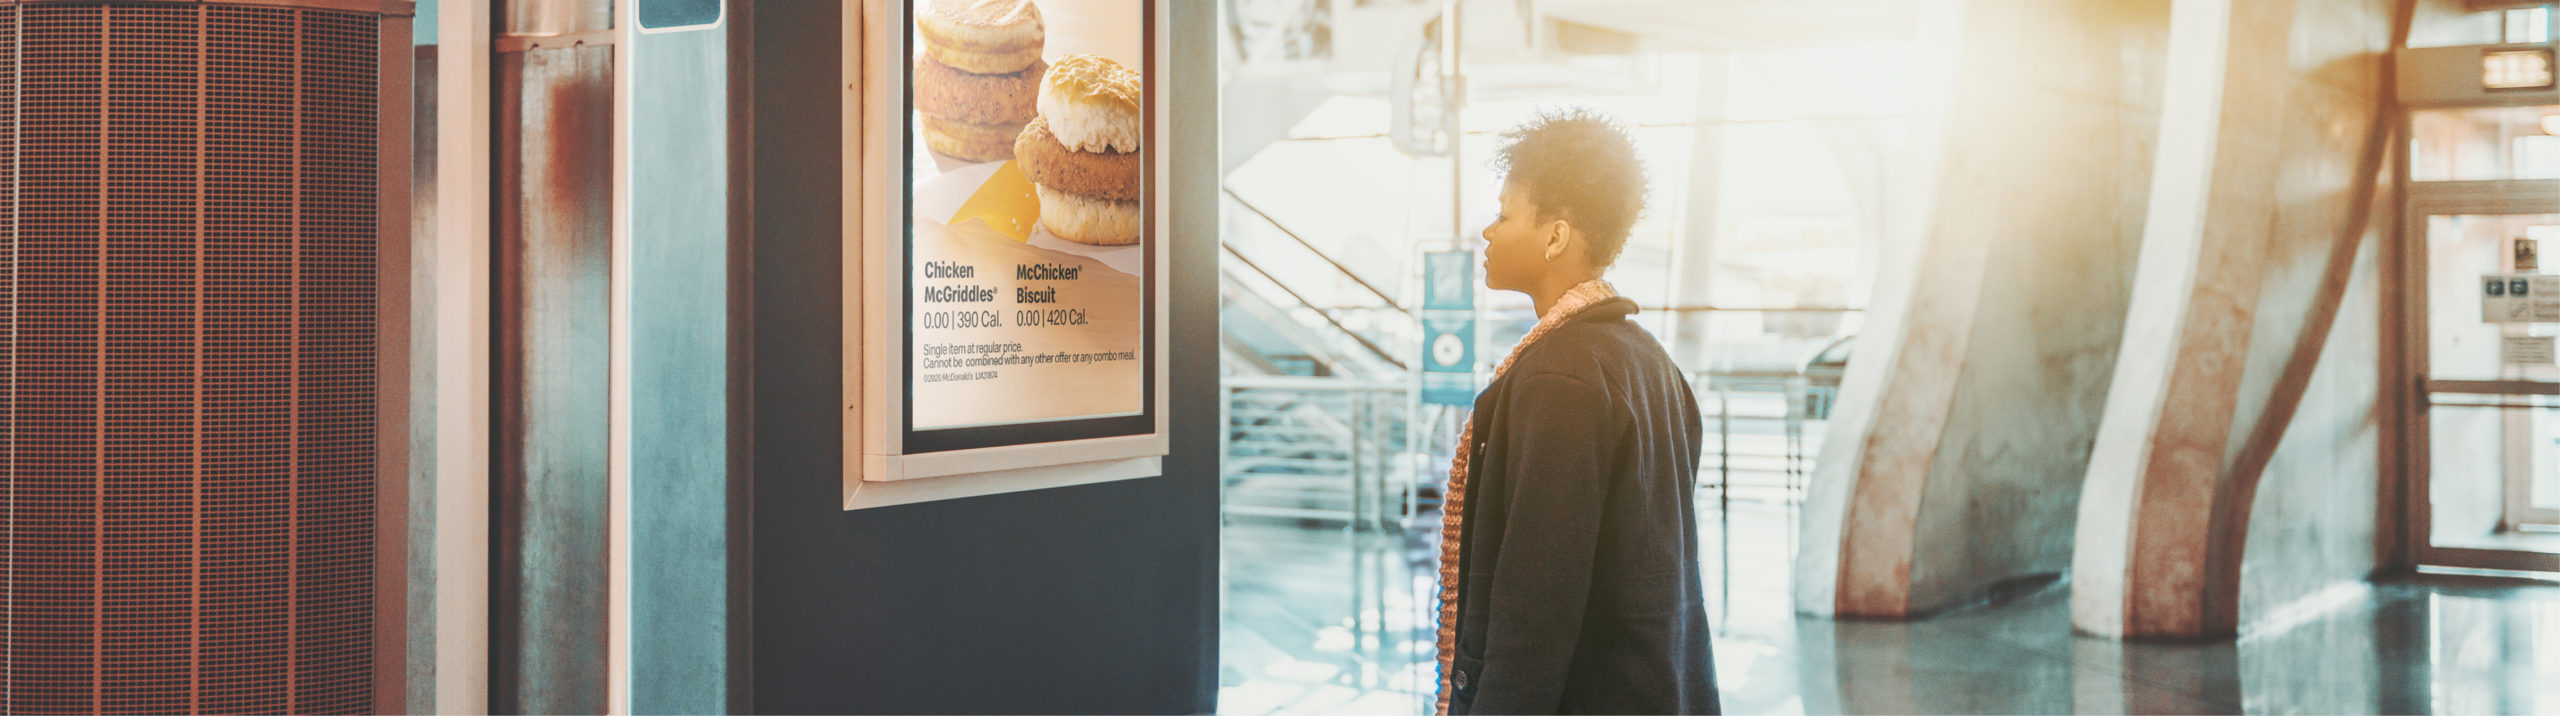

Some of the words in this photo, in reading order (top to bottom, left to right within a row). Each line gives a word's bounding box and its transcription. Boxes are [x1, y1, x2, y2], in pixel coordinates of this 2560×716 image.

[924, 260, 974, 279] Chicken
[1016, 285, 1056, 304] Biscuit
[924, 311, 950, 329] 0.00
[957, 311, 979, 328] 390
[981, 309, 1002, 328] Cal.
[1016, 310, 1040, 327] 0.00
[1047, 309, 1067, 326] 420
[1069, 308, 1088, 325] Cal.
[923, 342, 947, 358] Single
[948, 342, 966, 355] item
[967, 342, 975, 354] at
[976, 341, 1002, 357] regular
[1003, 341, 1023, 355] price.
[923, 357, 952, 369] Cannot
[953, 356, 963, 368] be
[965, 355, 1003, 367] combined
[1004, 354, 1020, 365] with
[1021, 355, 1034, 367] any
[1035, 352, 1053, 364] other
[1055, 351, 1071, 363] offer
[1072, 353, 1080, 363] or
[1081, 353, 1093, 364] any
[1093, 349, 1117, 361] combo
